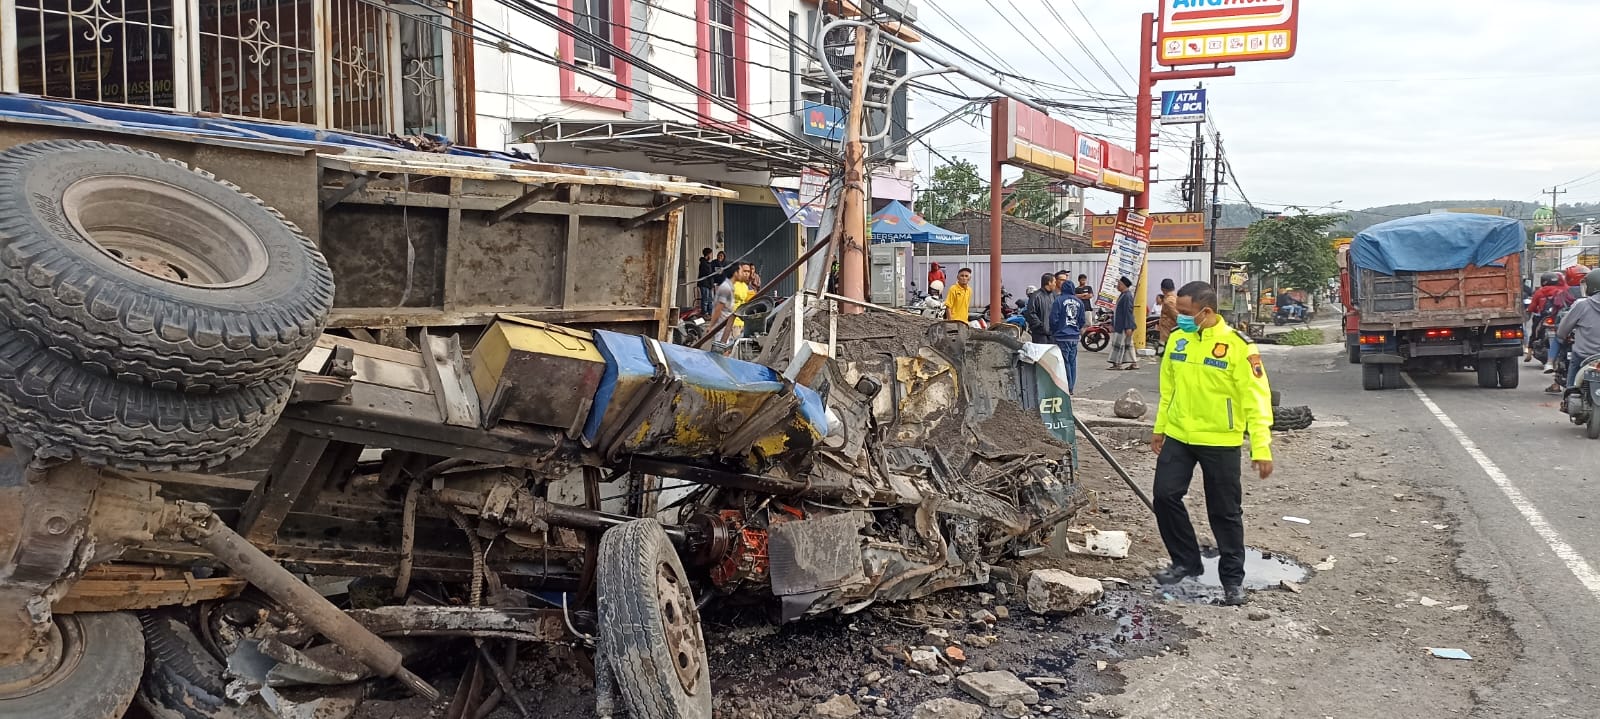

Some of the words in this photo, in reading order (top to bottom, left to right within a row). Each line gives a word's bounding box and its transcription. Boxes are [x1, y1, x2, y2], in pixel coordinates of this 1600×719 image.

[1176, 92, 1198, 102] ATM
[1182, 102, 1202, 112] BCA
[1175, 213, 1202, 223] TRI
